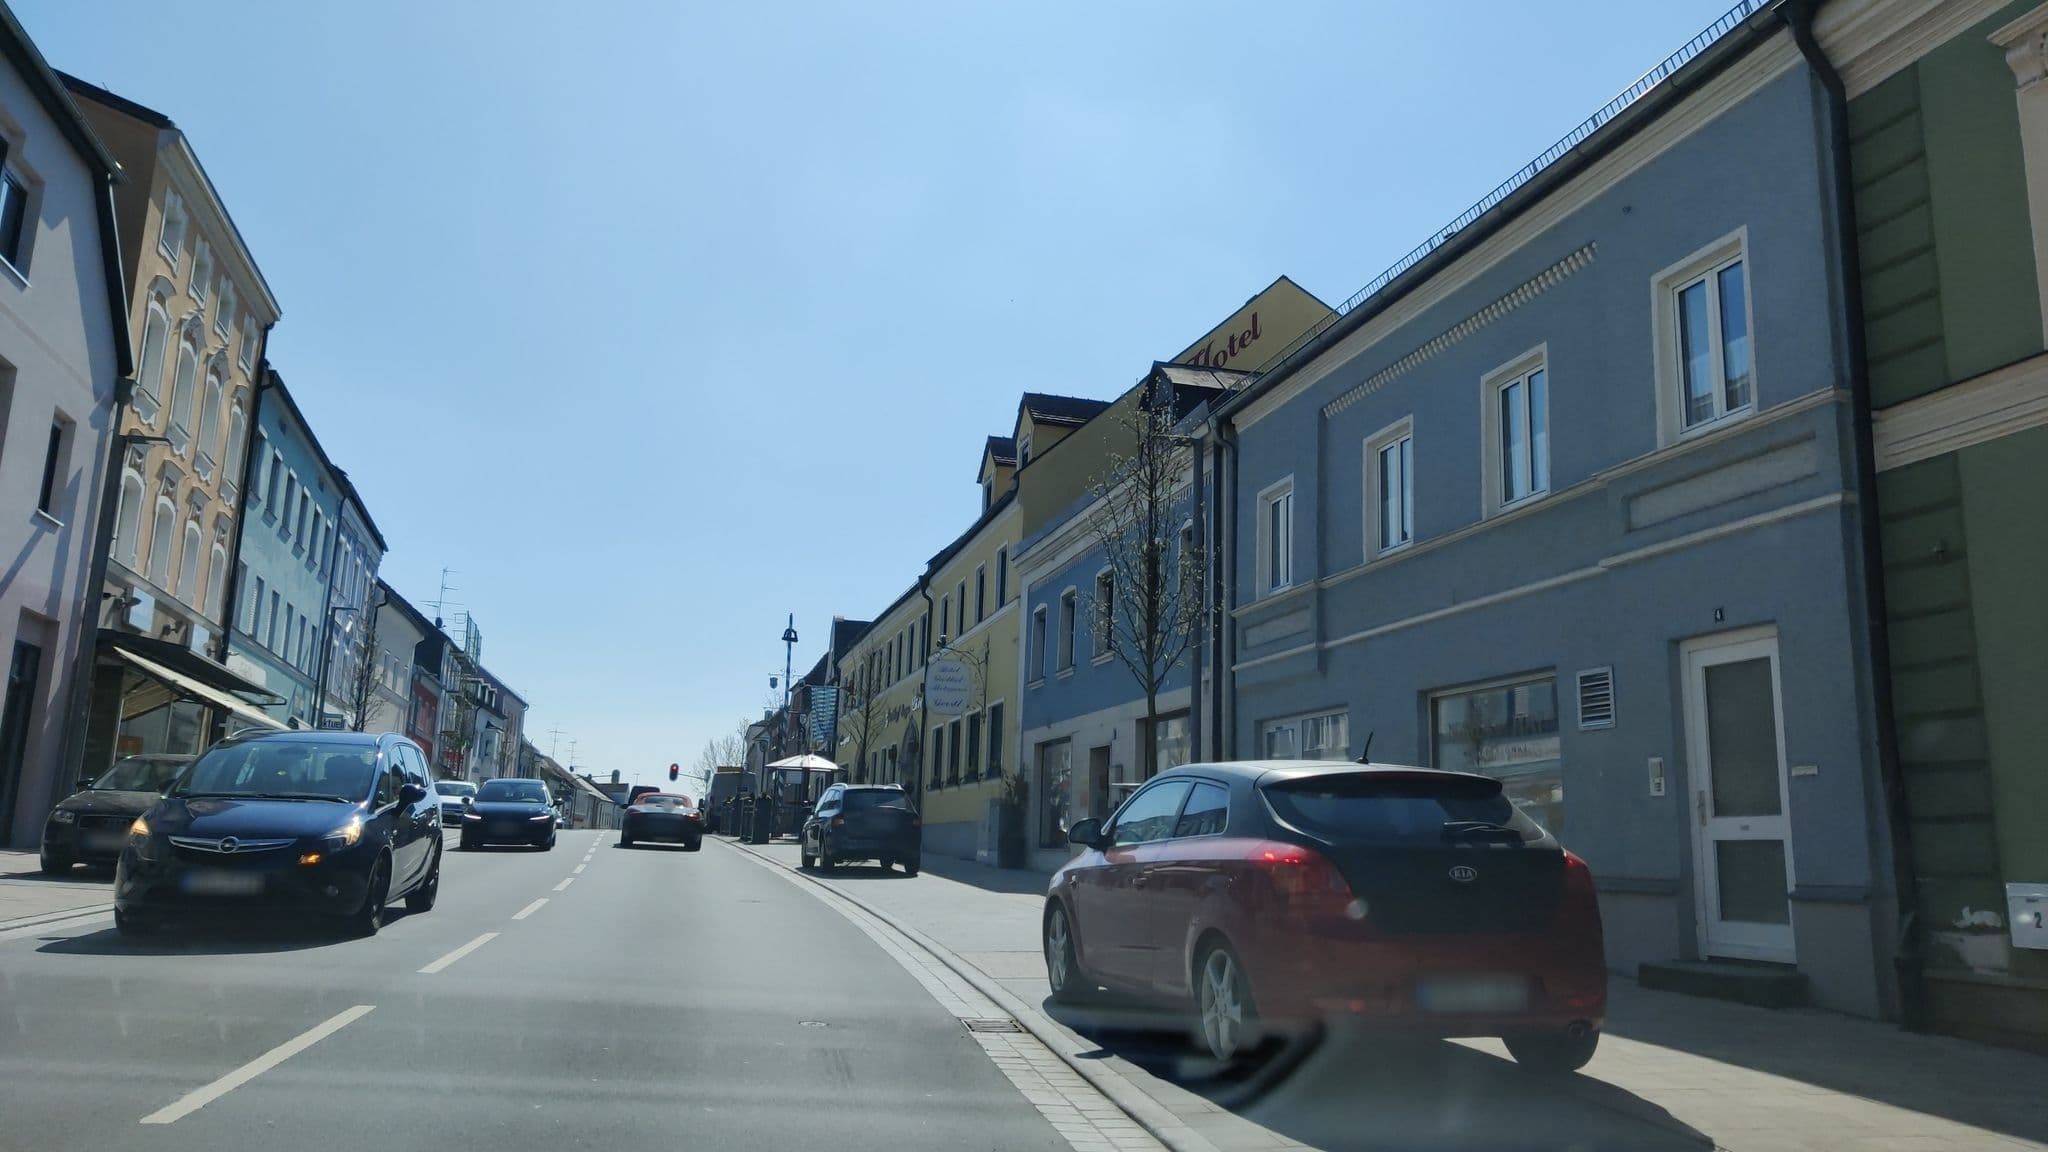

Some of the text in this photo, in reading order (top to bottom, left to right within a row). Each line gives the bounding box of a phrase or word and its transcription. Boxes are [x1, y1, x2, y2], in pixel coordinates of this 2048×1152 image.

[1186, 312, 1262, 369] Hotel
[1454, 867, 1473, 878] KIA
[2033, 911, 2043, 928] 2
